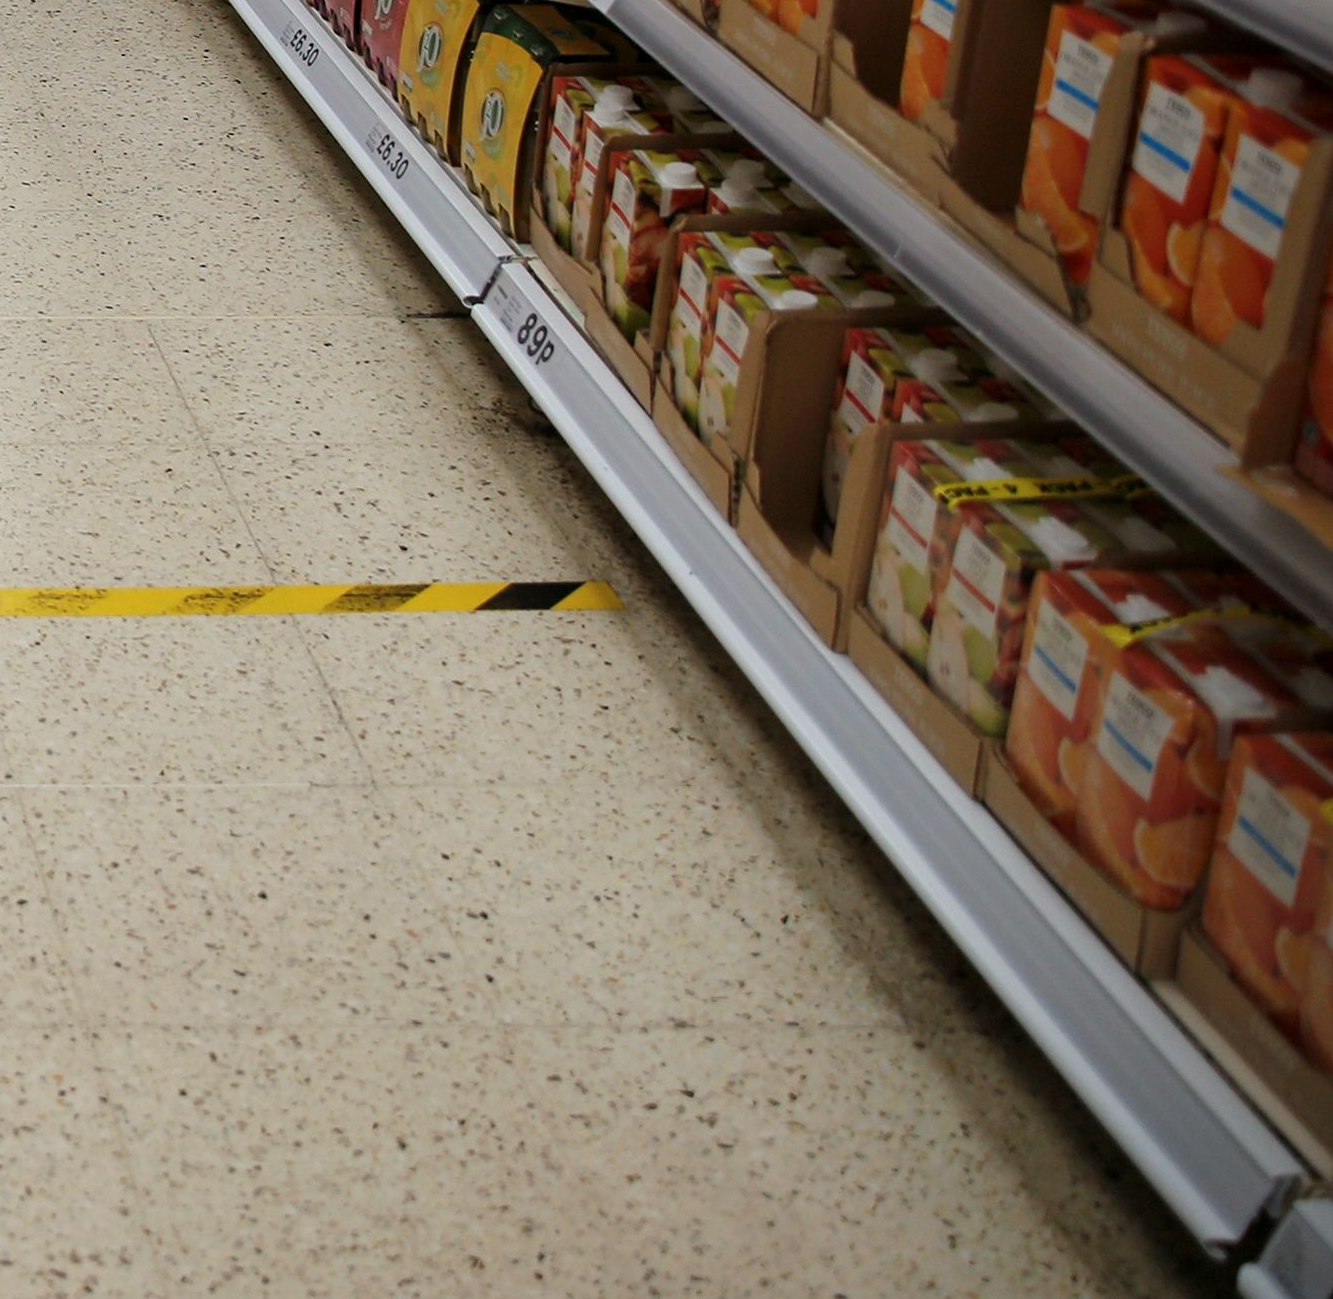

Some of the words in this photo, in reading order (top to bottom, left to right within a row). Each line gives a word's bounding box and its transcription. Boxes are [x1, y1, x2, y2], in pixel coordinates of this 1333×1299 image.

[289, 28, 319, 68] £6.30
[376, 133, 410, 180] £6.30
[517, 312, 555, 365] 89p
